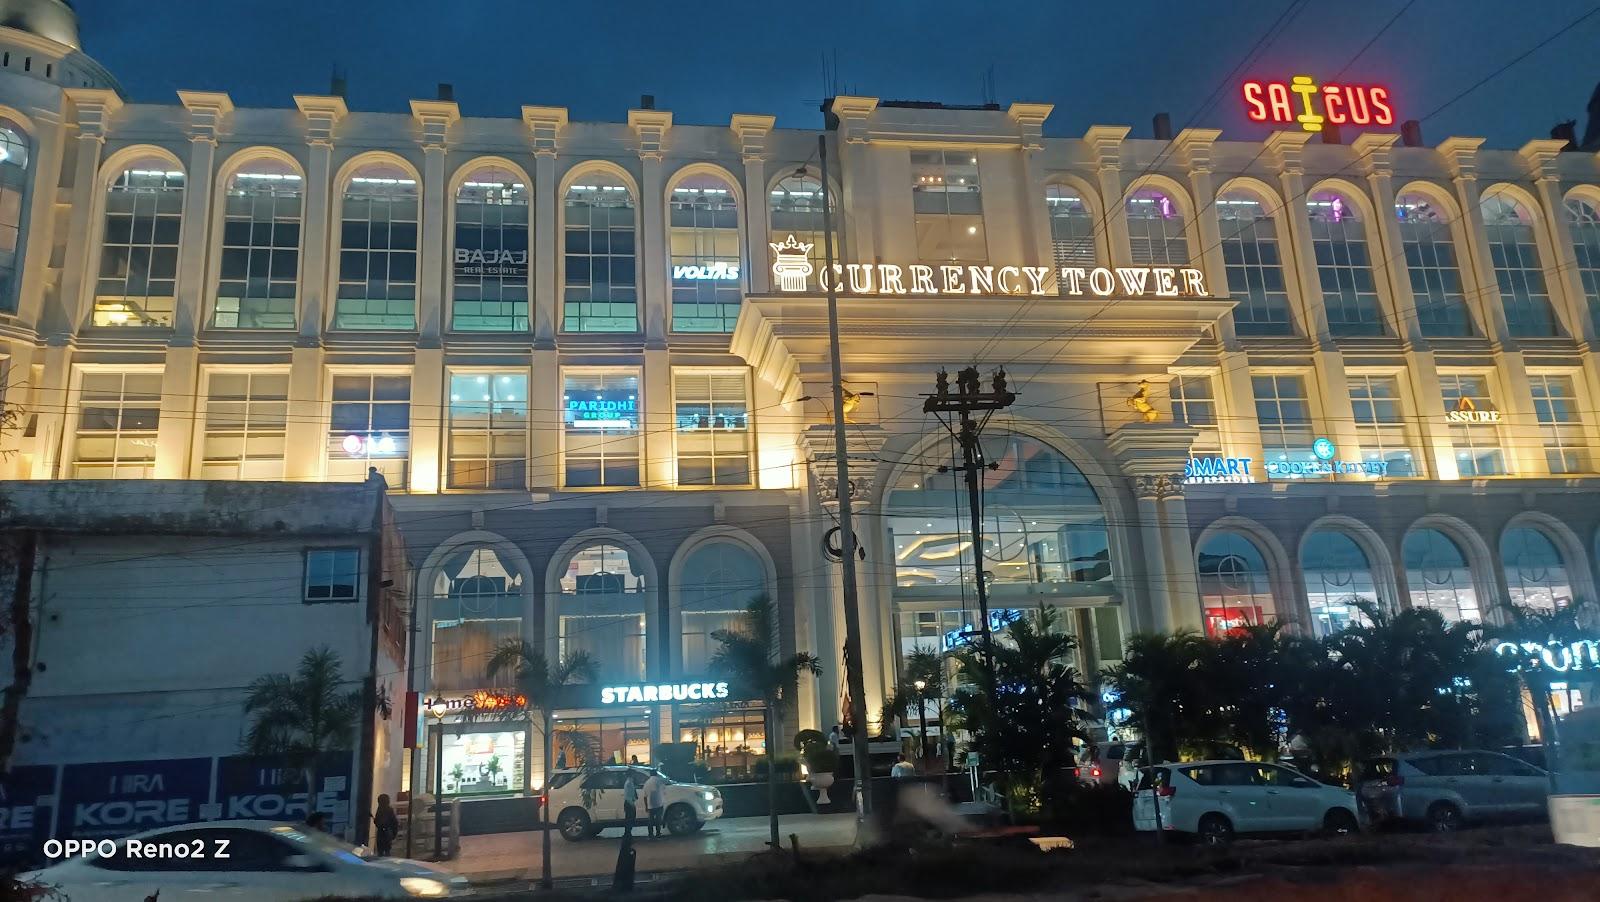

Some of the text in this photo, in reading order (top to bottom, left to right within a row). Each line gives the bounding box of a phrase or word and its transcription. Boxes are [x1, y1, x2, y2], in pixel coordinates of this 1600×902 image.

[455, 248, 527, 264] BAJAJ
[673, 262, 739, 280] VOLTAS
[819, 263, 1209, 296] CURRENCY TOWER
[569, 401, 635, 411] PARIDHI
[583, 411, 621, 420] GROUP
[1184, 457, 1252, 477] SMART
[601, 682, 729, 704] STARBUCKS
[74, 798, 189, 826] KORE
